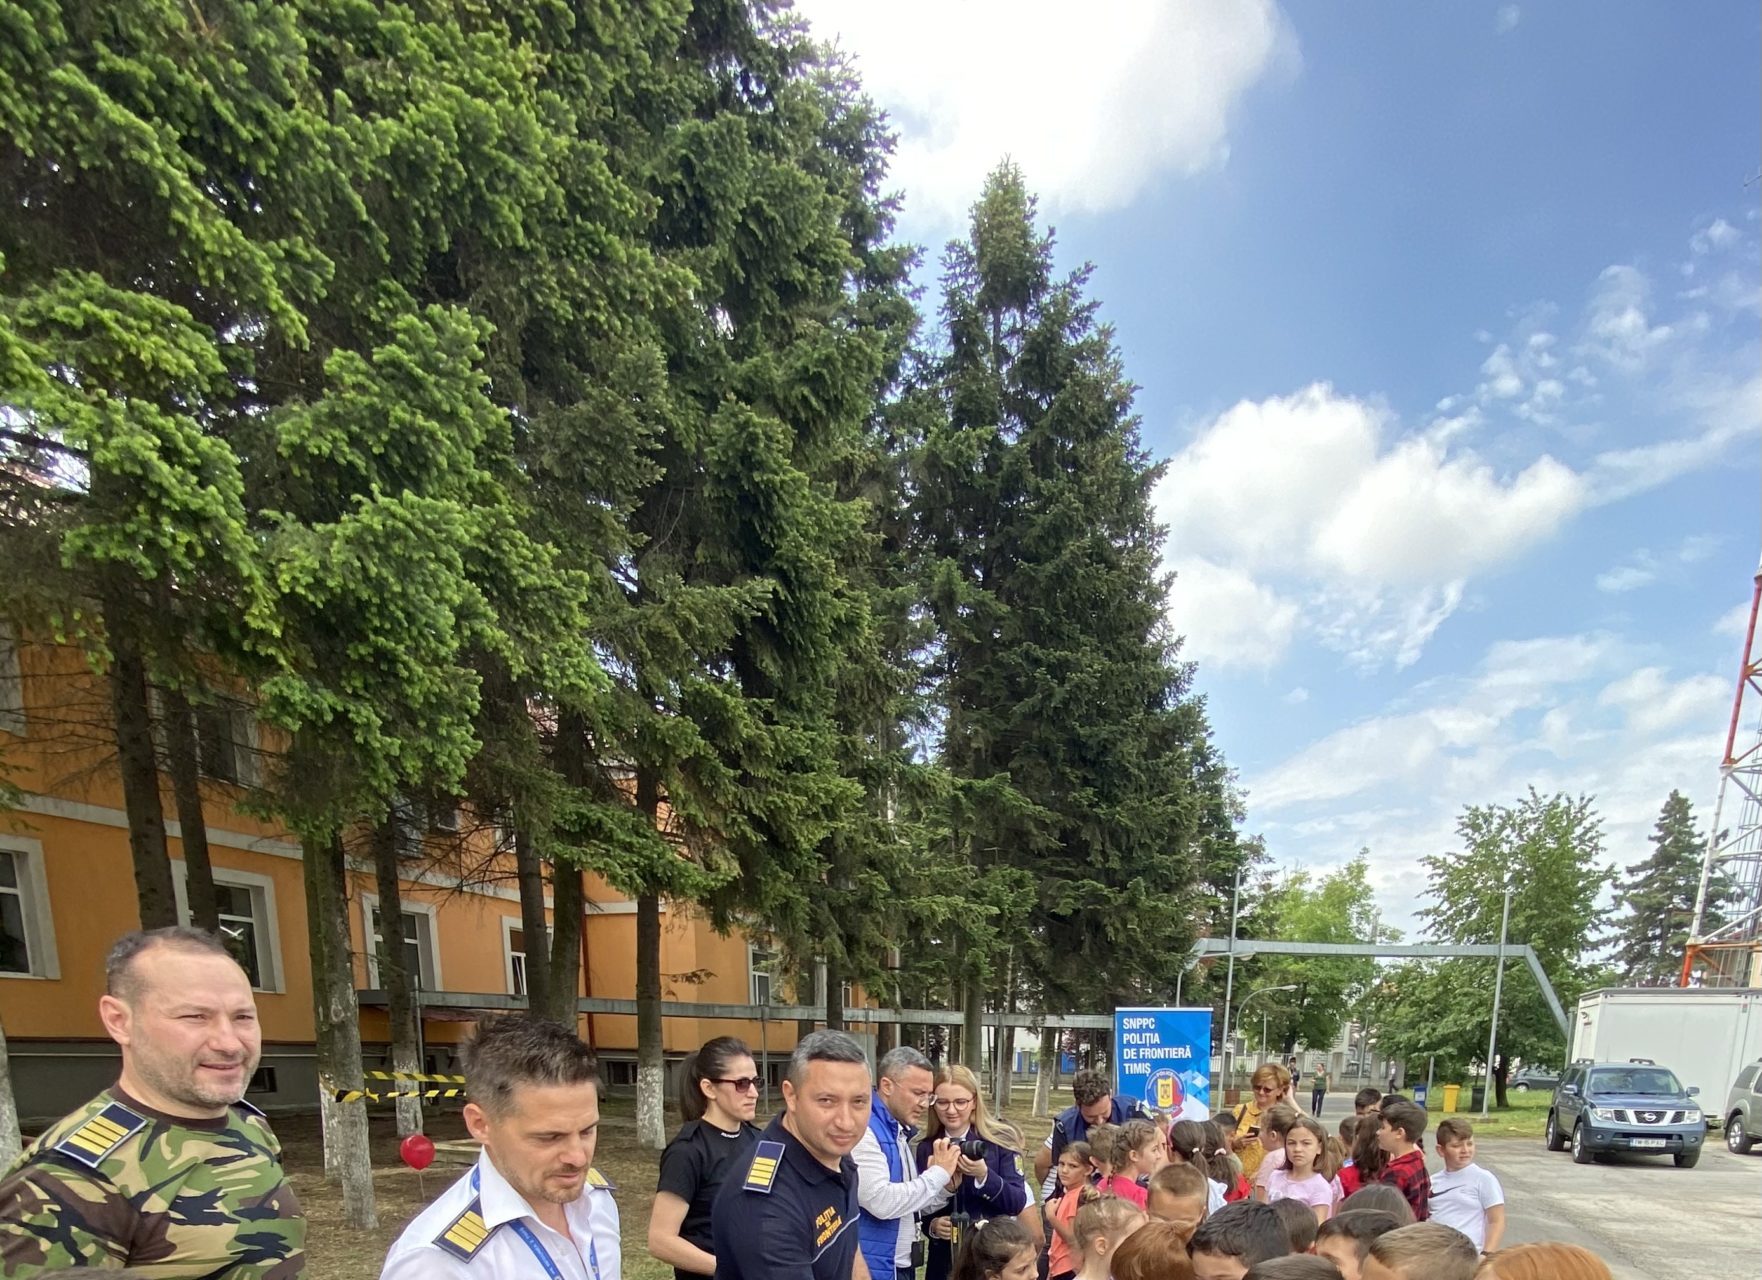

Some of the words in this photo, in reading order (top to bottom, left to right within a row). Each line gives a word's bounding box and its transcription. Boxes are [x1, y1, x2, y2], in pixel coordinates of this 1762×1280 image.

[1123, 1018, 1155, 1029] SNPPC
[1123, 1033, 1160, 1047] POLIȚIA
[1123, 1048, 1137, 1059] DE
[1140, 1045, 1192, 1059] FRONTIERĂ
[1123, 1063, 1151, 1077] TIMIȘ
